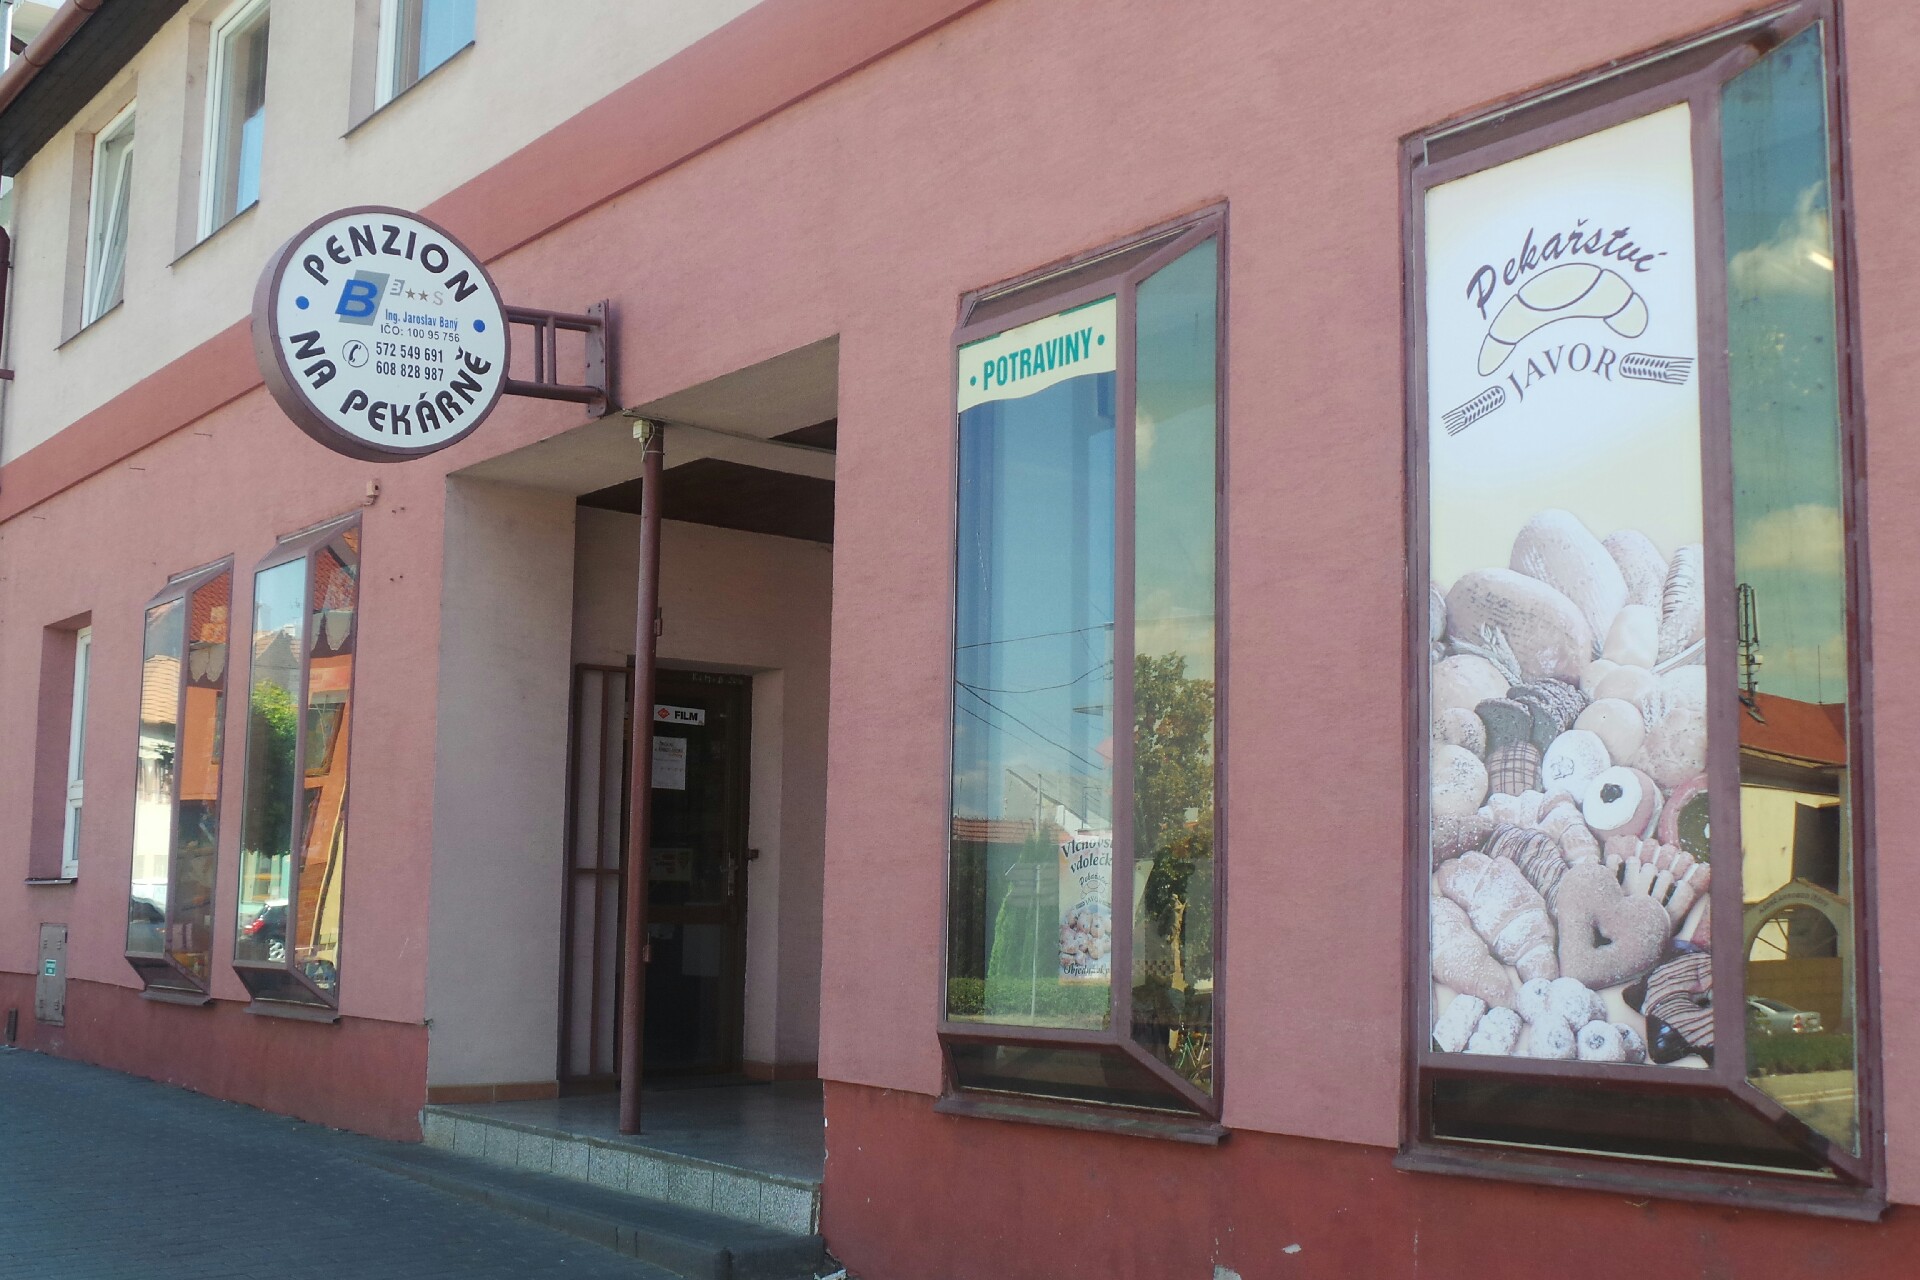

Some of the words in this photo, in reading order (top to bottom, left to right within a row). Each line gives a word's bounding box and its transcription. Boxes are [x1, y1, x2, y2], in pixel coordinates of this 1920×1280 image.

[303, 224, 479, 302] PENZION
[385, 308, 401, 324] Ing.
[403, 311, 437, 326] Jaroslav
[380, 323, 404, 336] IČO:
[407, 328, 425, 339] 100
[427, 330, 440, 340] 95
[443, 331, 460, 342] 756
[376, 341, 396, 357] 572
[400, 344, 420, 360] 549
[424, 347, 443, 363] 691
[983, 326, 1093, 391] POTRAVINY
[376, 360, 396, 376] 608
[400, 363, 420, 379] 828
[424, 366, 444, 382] 987
[1507, 342, 1616, 403] JAVOR
[289, 330, 337, 390] NA
[340, 346, 492, 436] PEKÁRNĚ
[674, 710, 698, 722] FILM
